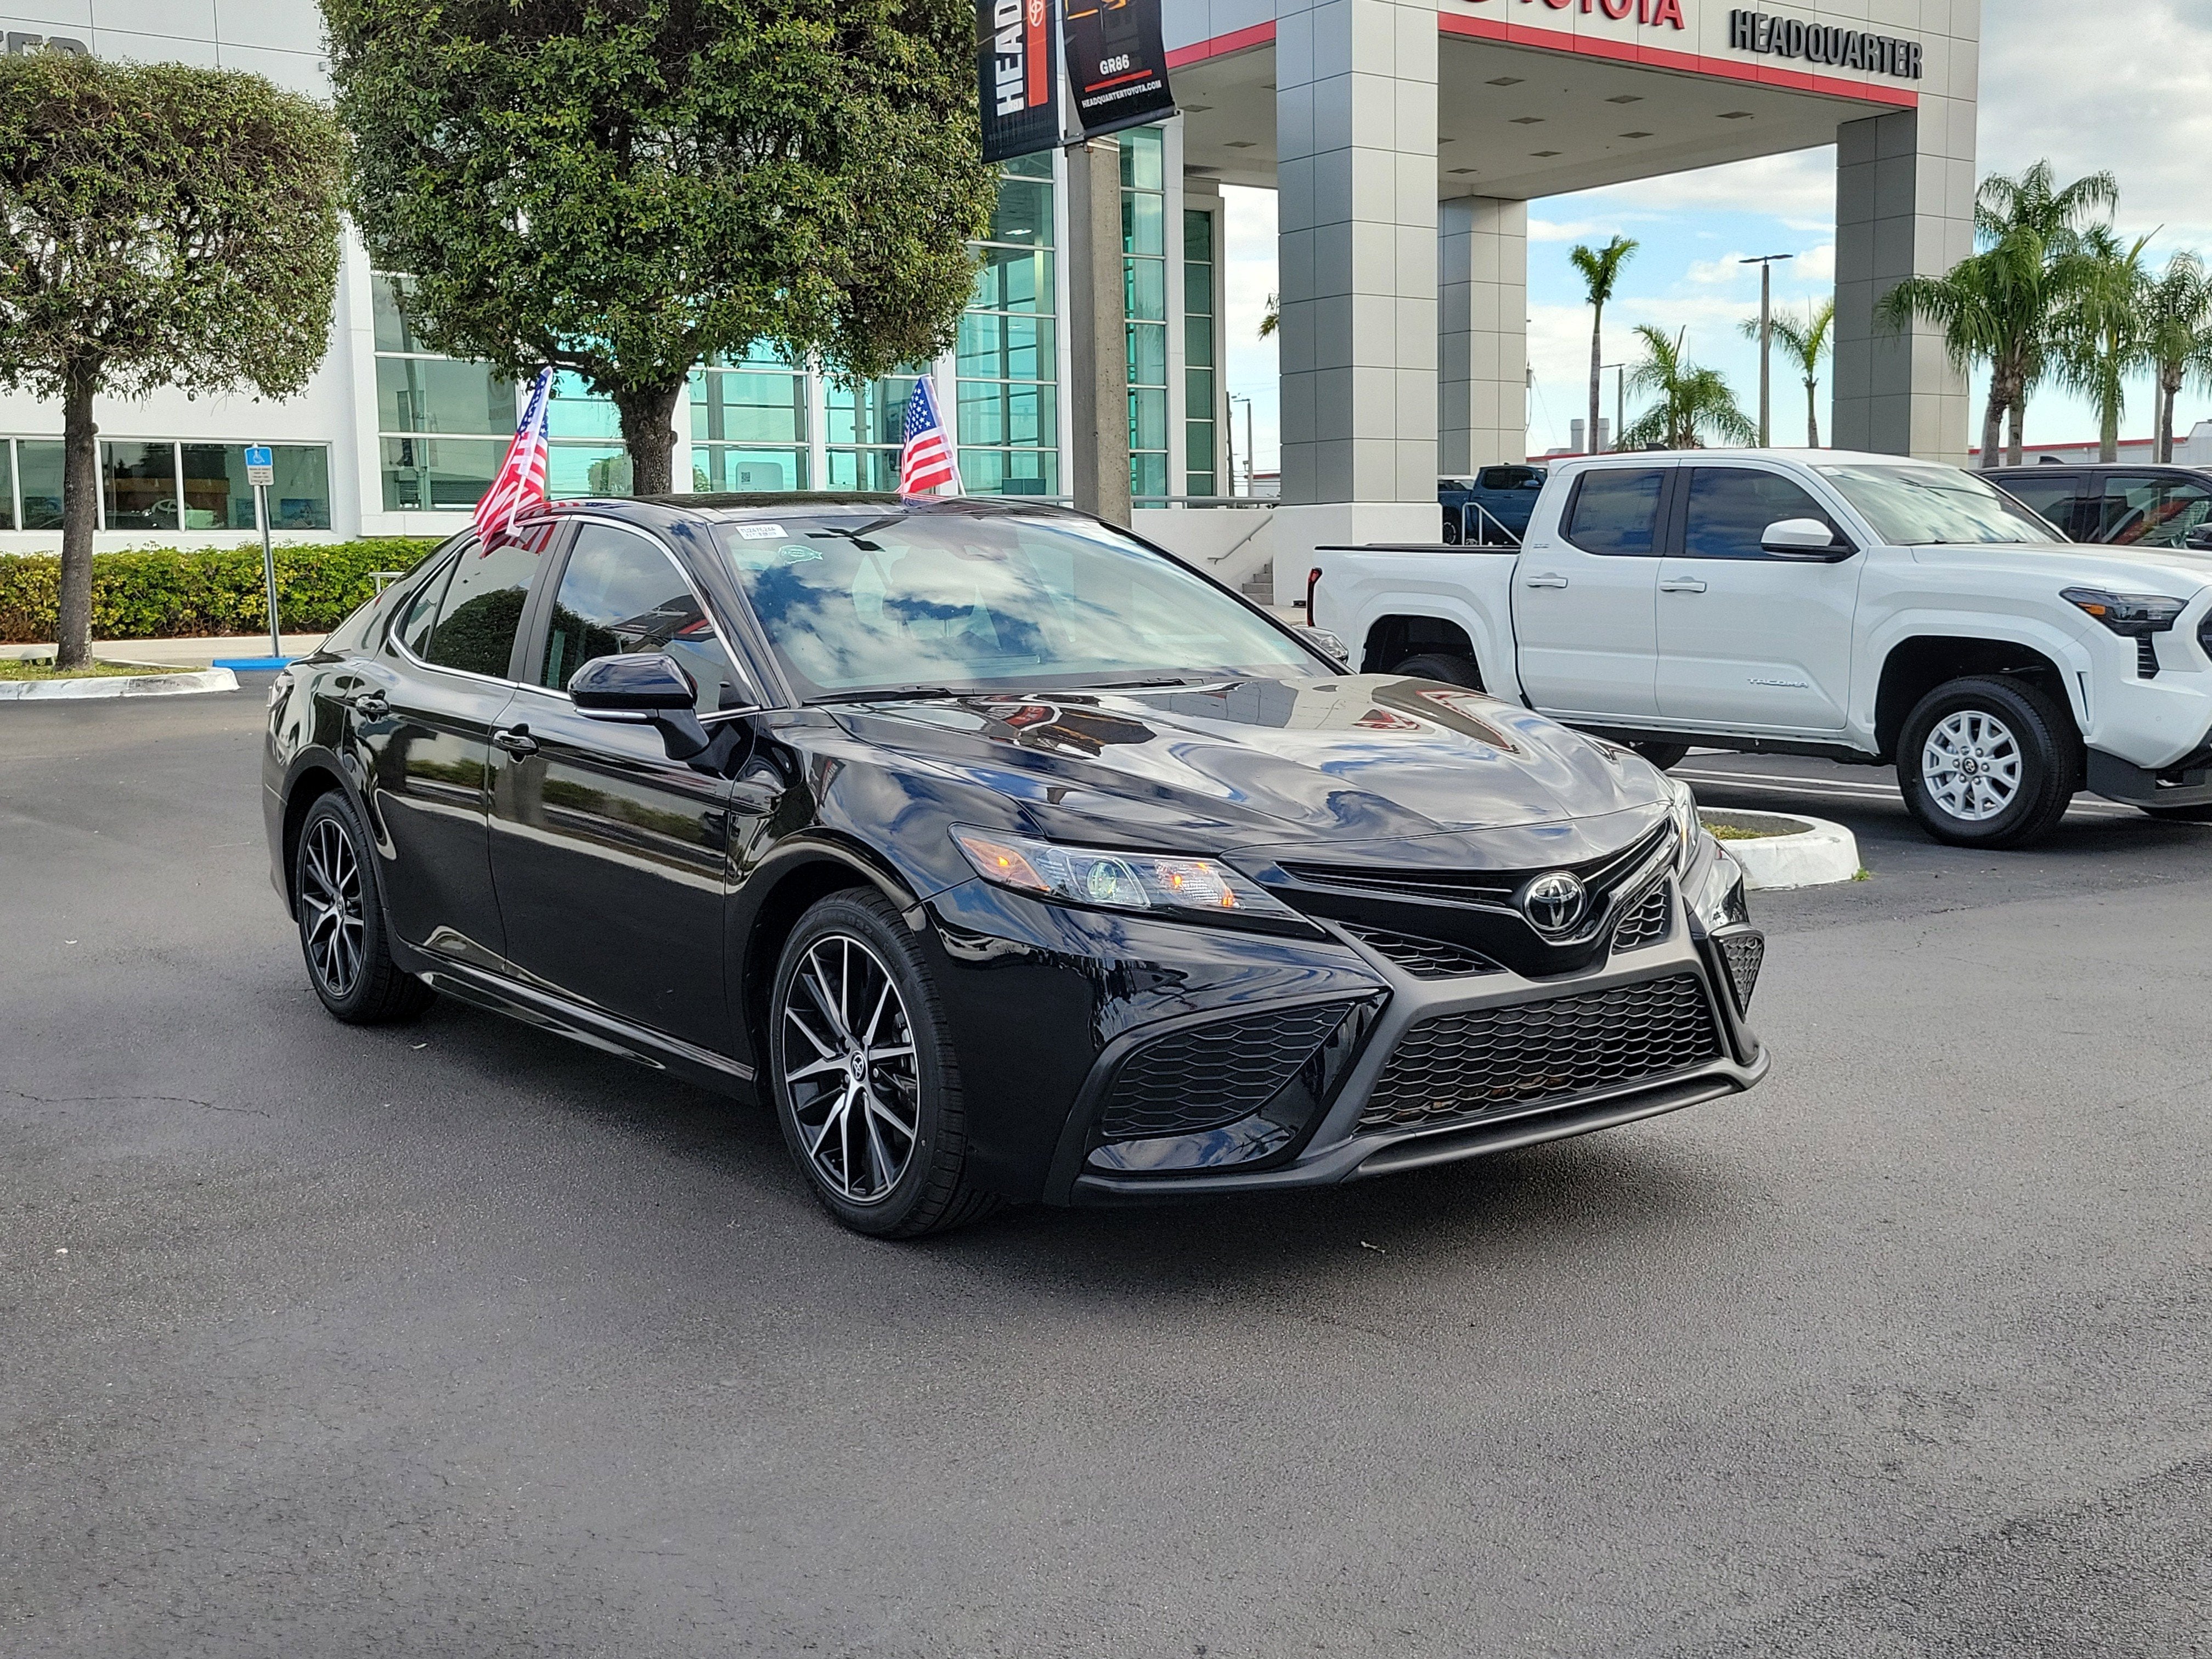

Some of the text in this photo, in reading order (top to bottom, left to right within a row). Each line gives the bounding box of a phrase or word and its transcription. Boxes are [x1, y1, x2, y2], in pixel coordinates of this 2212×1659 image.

[994, 0, 1024, 117] HEAD
[1099, 54, 1130, 75] GR86
[1730, 9, 1922, 79] HEADQUARTER
[1081, 80, 1162, 109] HEADQUARTERTOYOTA.COM
